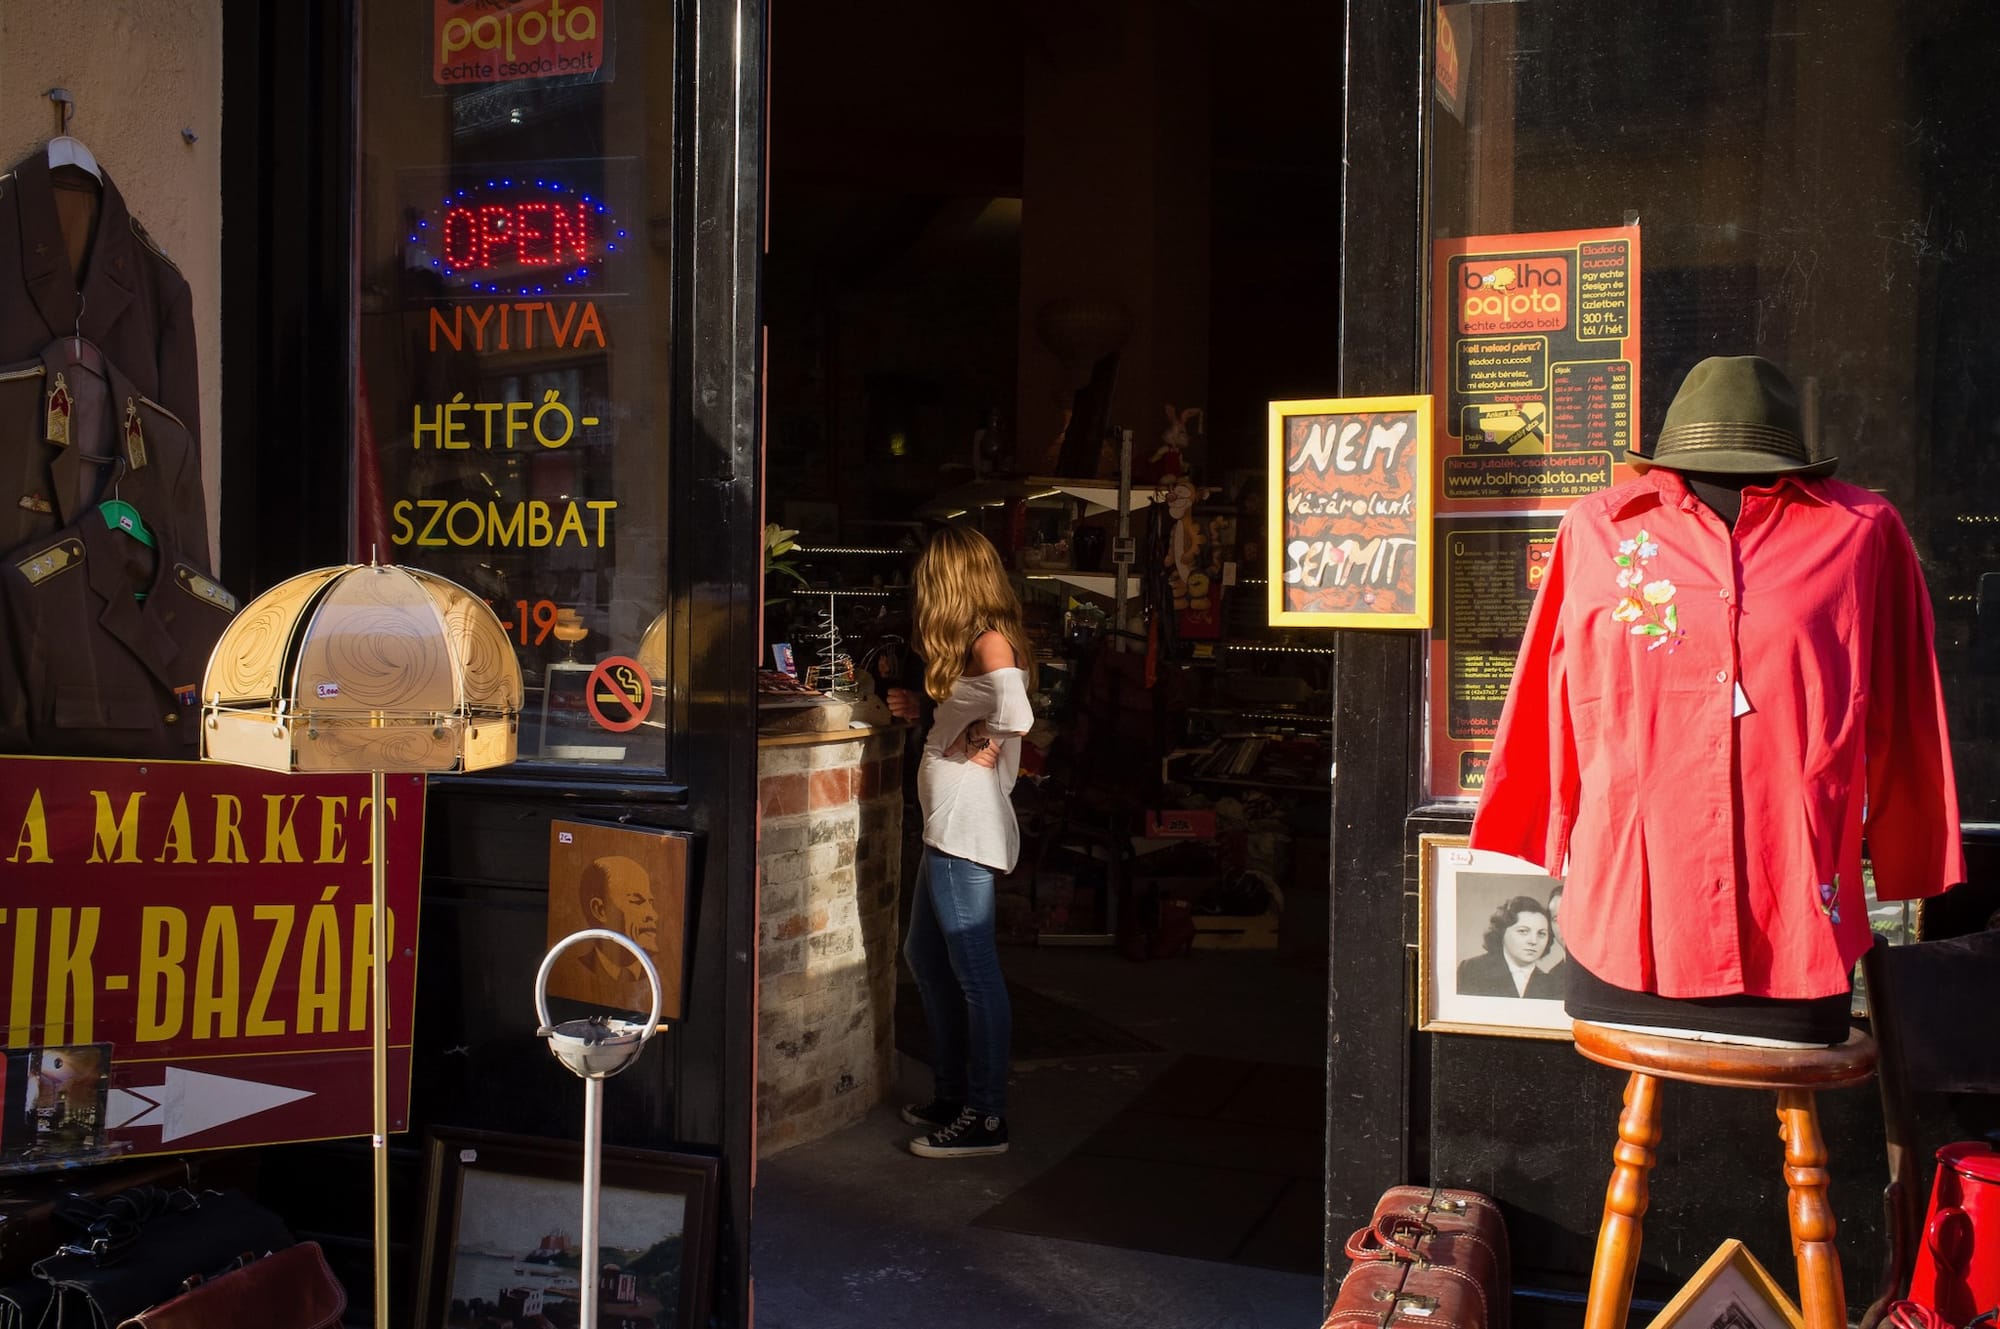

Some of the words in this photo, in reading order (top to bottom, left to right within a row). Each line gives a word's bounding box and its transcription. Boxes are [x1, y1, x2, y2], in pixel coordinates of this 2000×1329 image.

[441, 0, 597, 64] palota
[441, 62, 493, 80] echte
[498, 57, 553, 76] csoda
[558, 52, 594, 71] bolt
[445, 202, 588, 269] OPEN
[1582, 272, 1598, 281] egy
[1600, 270, 1625, 279] echte
[1582, 282, 1612, 291] design
[1613, 281, 1624, 289] és
[1464, 288, 1562, 323] palota
[1582, 290, 1625, 299] second-hand
[1582, 300, 1625, 309] üzletben
[429, 301, 607, 351] NYITVA
[1464, 321, 1497, 331] echte
[1499, 319, 1534, 329] csoda
[1537, 317, 1561, 328] bolt
[1583, 313, 1602, 324] 300
[1583, 325, 1596, 335] tól
[1605, 324, 1623, 334] hét
[1481, 342, 1511, 353] neked
[1512, 341, 1542, 353] pénz?
[1289, 421, 1408, 473] NEM
[1549, 456, 1586, 466] bérleti
[1449, 470, 1606, 487] www.bolhapalota.net
[391, 500, 618, 547] SZOMBAT
[1283, 537, 1417, 587] SEMMIT
[86, 789, 397, 865] MARKET
[0, 886, 394, 1048] IK-BAZÁR
